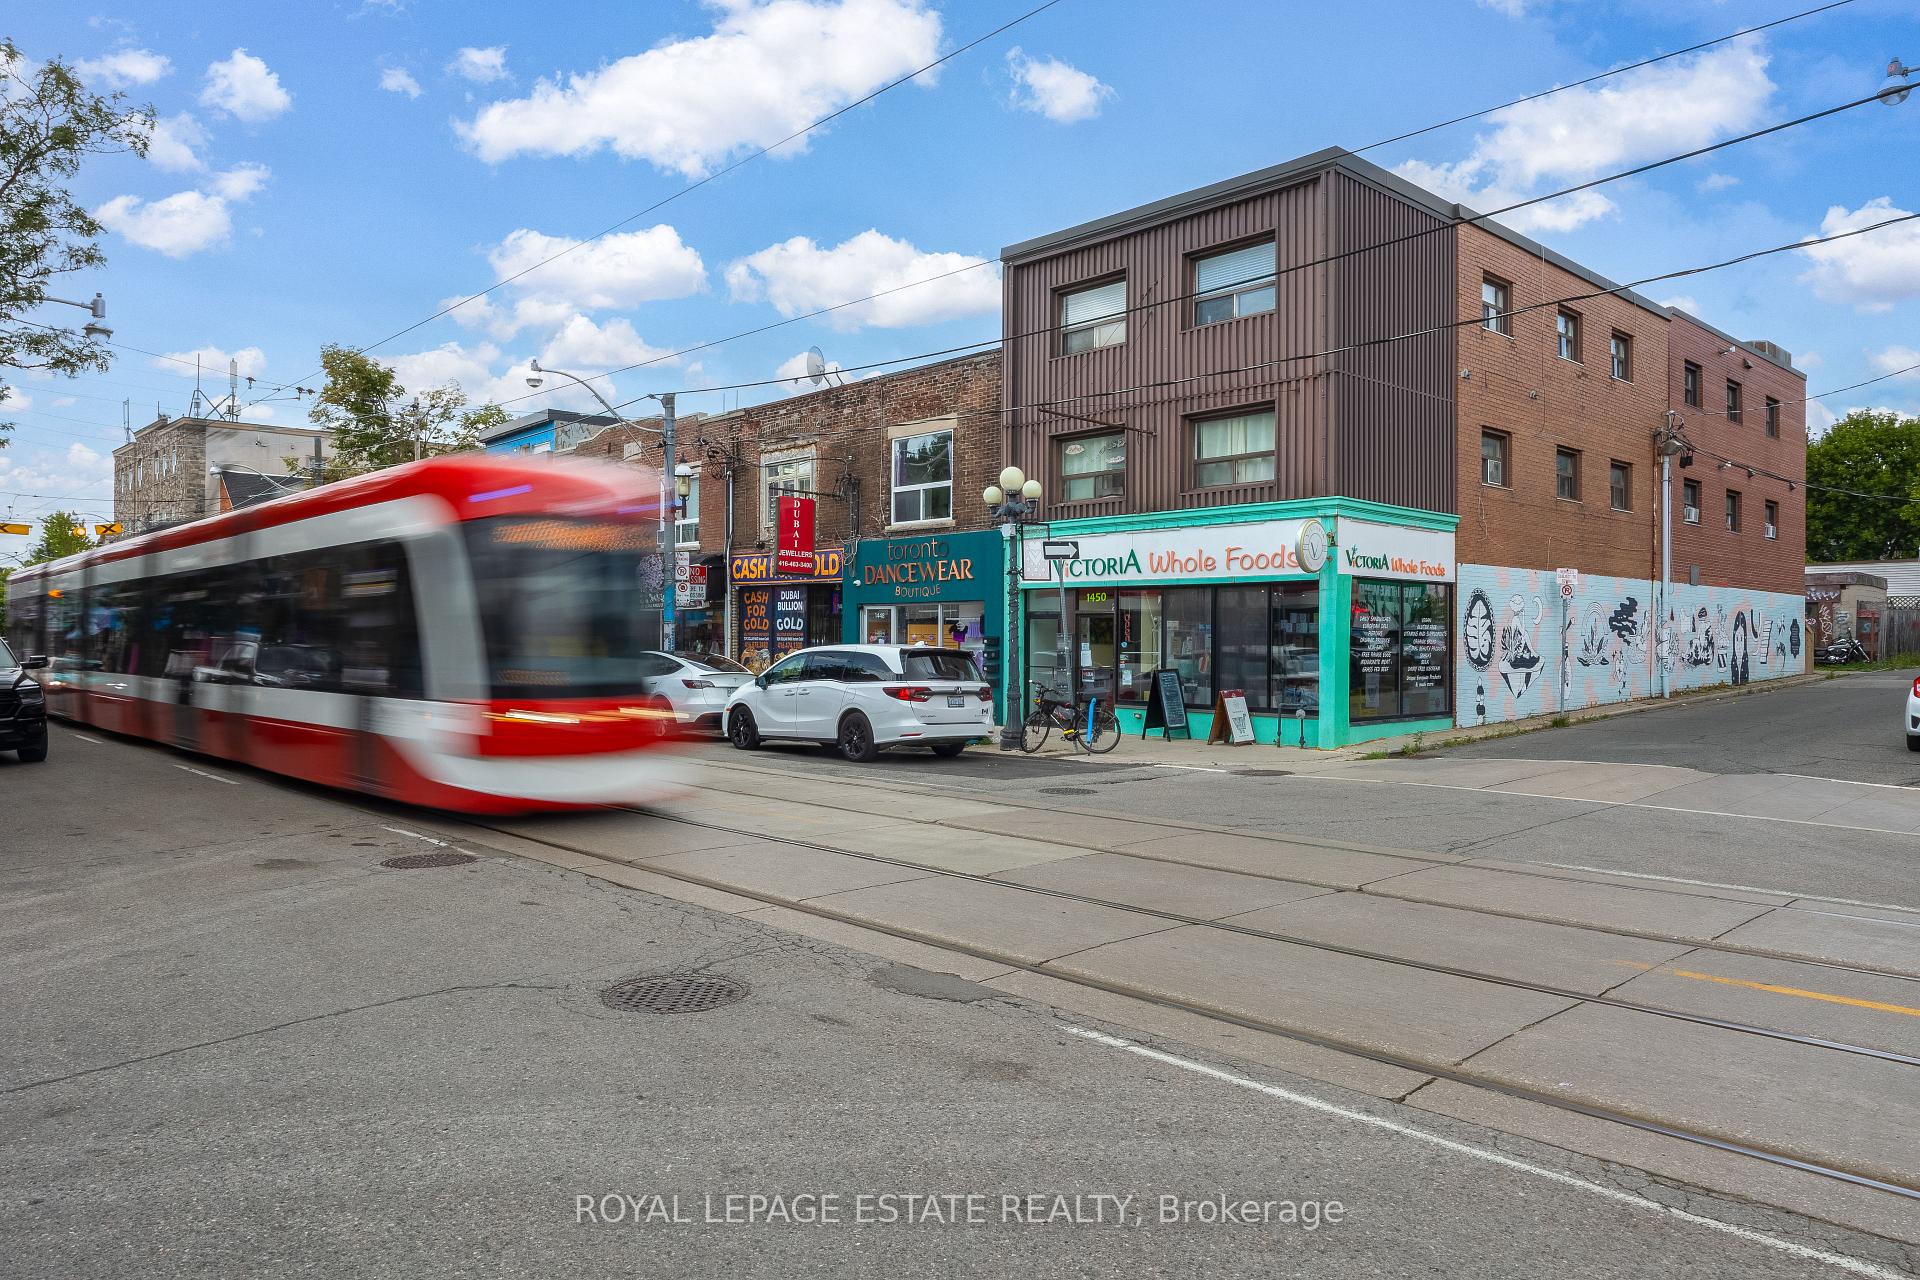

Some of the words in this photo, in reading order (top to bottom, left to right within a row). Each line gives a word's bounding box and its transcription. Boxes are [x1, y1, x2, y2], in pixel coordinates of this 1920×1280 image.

[792, 500, 801, 548] DUBAI
[778, 549, 813, 559] JEWELLERS
[887, 538, 950, 560] toronto
[1149, 548, 1217, 574] Whole
[1225, 544, 1301, 571] Foods
[690, 567, 700, 576] NO
[732, 558, 768, 579] CASH
[864, 559, 974, 585] DANCEWEAR
[1391, 557, 1418, 574] Whole
[1420, 560, 1446, 577] Foods
[690, 576, 706, 584] SSING
[744, 591, 769, 604] CASH
[780, 590, 800, 600] DUBAI
[895, 584, 941, 598] BOUTIQUE
[1087, 592, 1107, 603] 1450
[747, 604, 767, 617] FOR
[777, 601, 803, 611] BULLION
[743, 617, 770, 631] GOLD
[776, 617, 804, 631] GOLD
